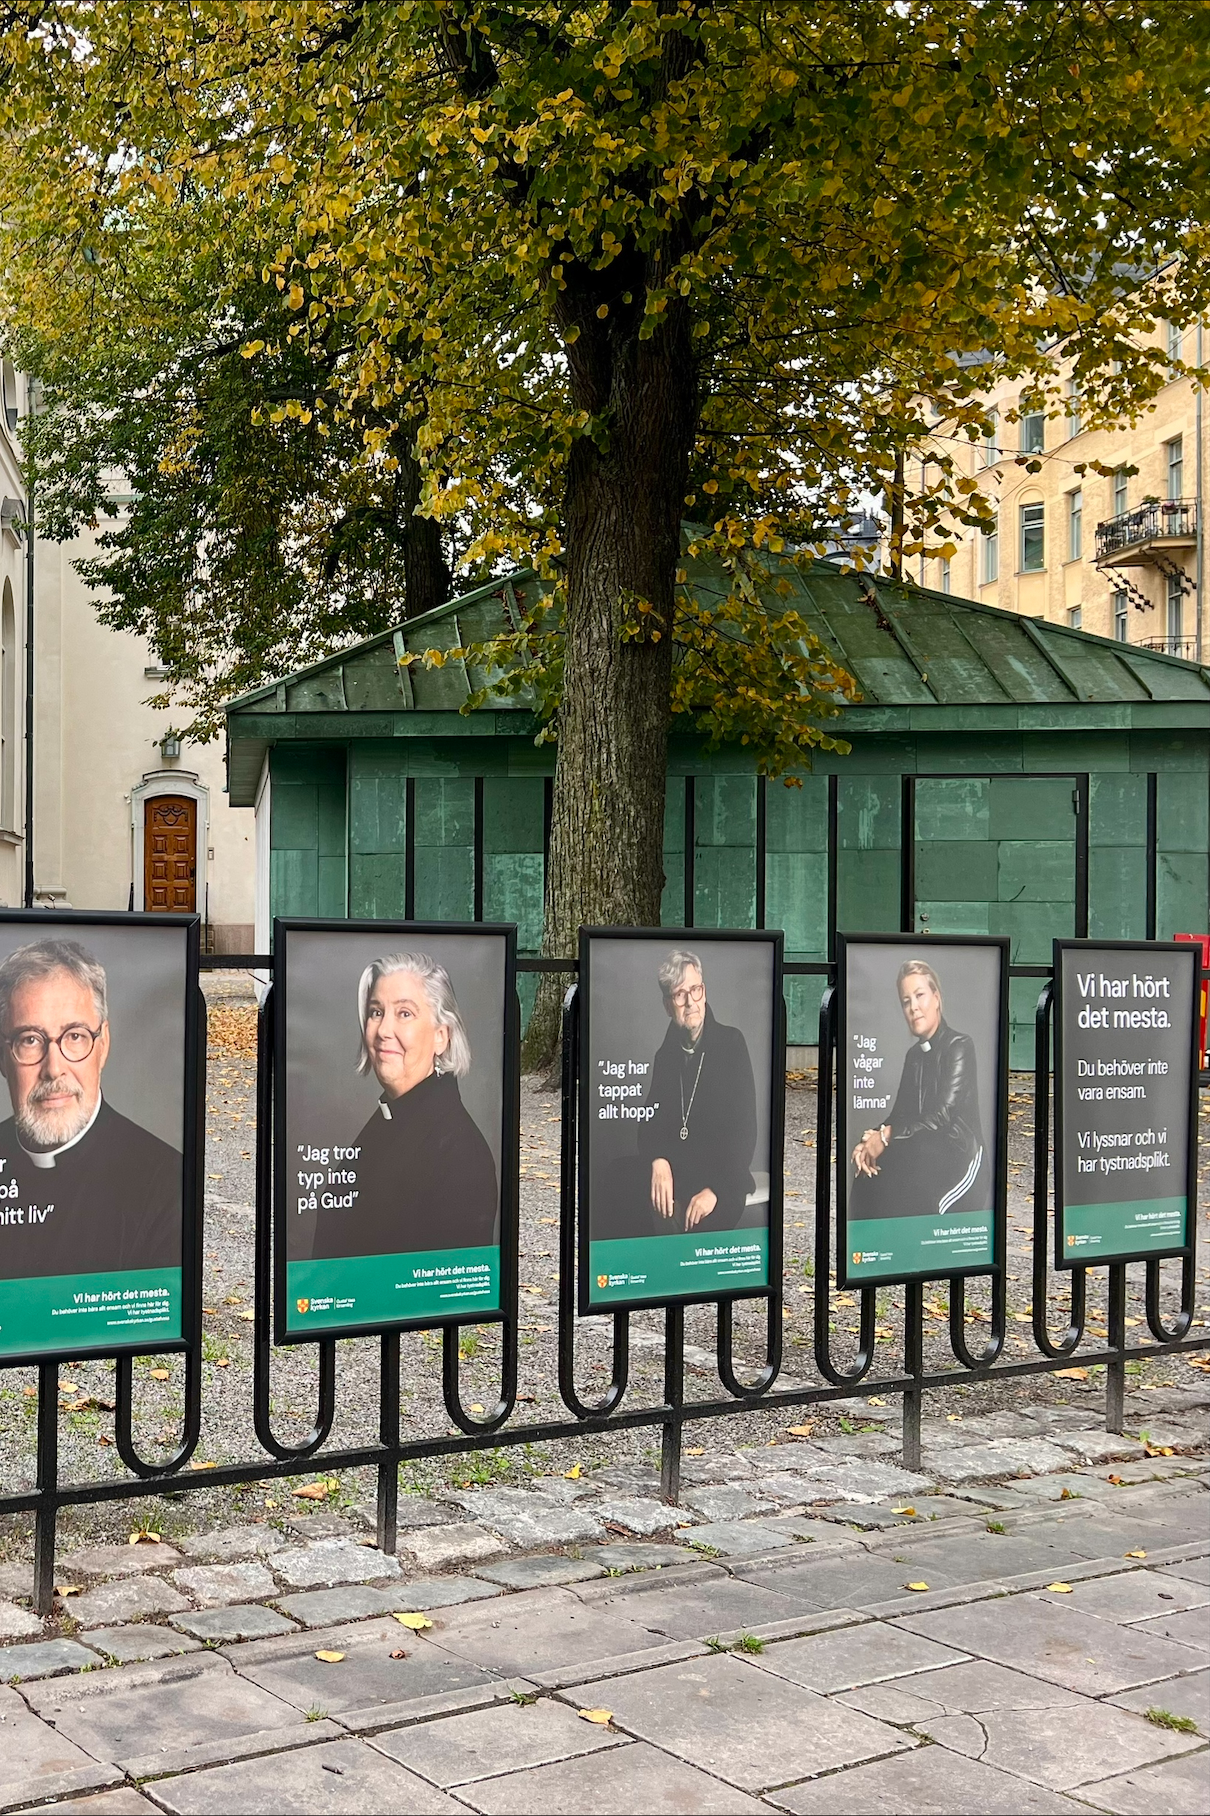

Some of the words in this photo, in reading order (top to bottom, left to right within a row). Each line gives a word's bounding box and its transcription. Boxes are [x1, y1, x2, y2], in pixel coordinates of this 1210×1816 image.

[1077, 973, 1095, 997] Vi
[1100, 974, 1129, 997] har
[1132, 974, 1170, 998] hört
[1078, 1004, 1109, 1028] det
[1114, 1007, 1171, 1028] mesta.
[628, 1060, 649, 1074] har
[853, 1053, 883, 1072] vågar
[1078, 1060, 1094, 1076] Du
[1098, 1059, 1146, 1076] behöver
[1148, 1058, 1168, 1074] inte
[853, 1075, 874, 1088] inte
[598, 1083, 642, 1101] tappat
[1078, 1087, 1103, 1100] vara
[1105, 1086, 1146, 1099] ensam.
[598, 1104, 618, 1119] allt
[1077, 1131, 1090, 1148] Vi
[1093, 1131, 1133, 1152] lyssnar
[1135, 1128, 1155, 1145] och
[1157, 1127, 1167, 1144] vi
[333, 1145, 361, 1160] tror
[1078, 1156, 1098, 1172] har
[1099, 1151, 1170, 1175] tystnadsplikt.
[297, 1171, 324, 1190] typ
[328, 1168, 356, 1184] inte
[298, 1191, 317, 1214] på
[73, 1293, 83, 1303] Vi
[84, 1293, 100, 1303] har
[101, 1291, 121, 1301] hört
[122, 1290, 138, 1300] det
[140, 1288, 170, 1298] mesta.
